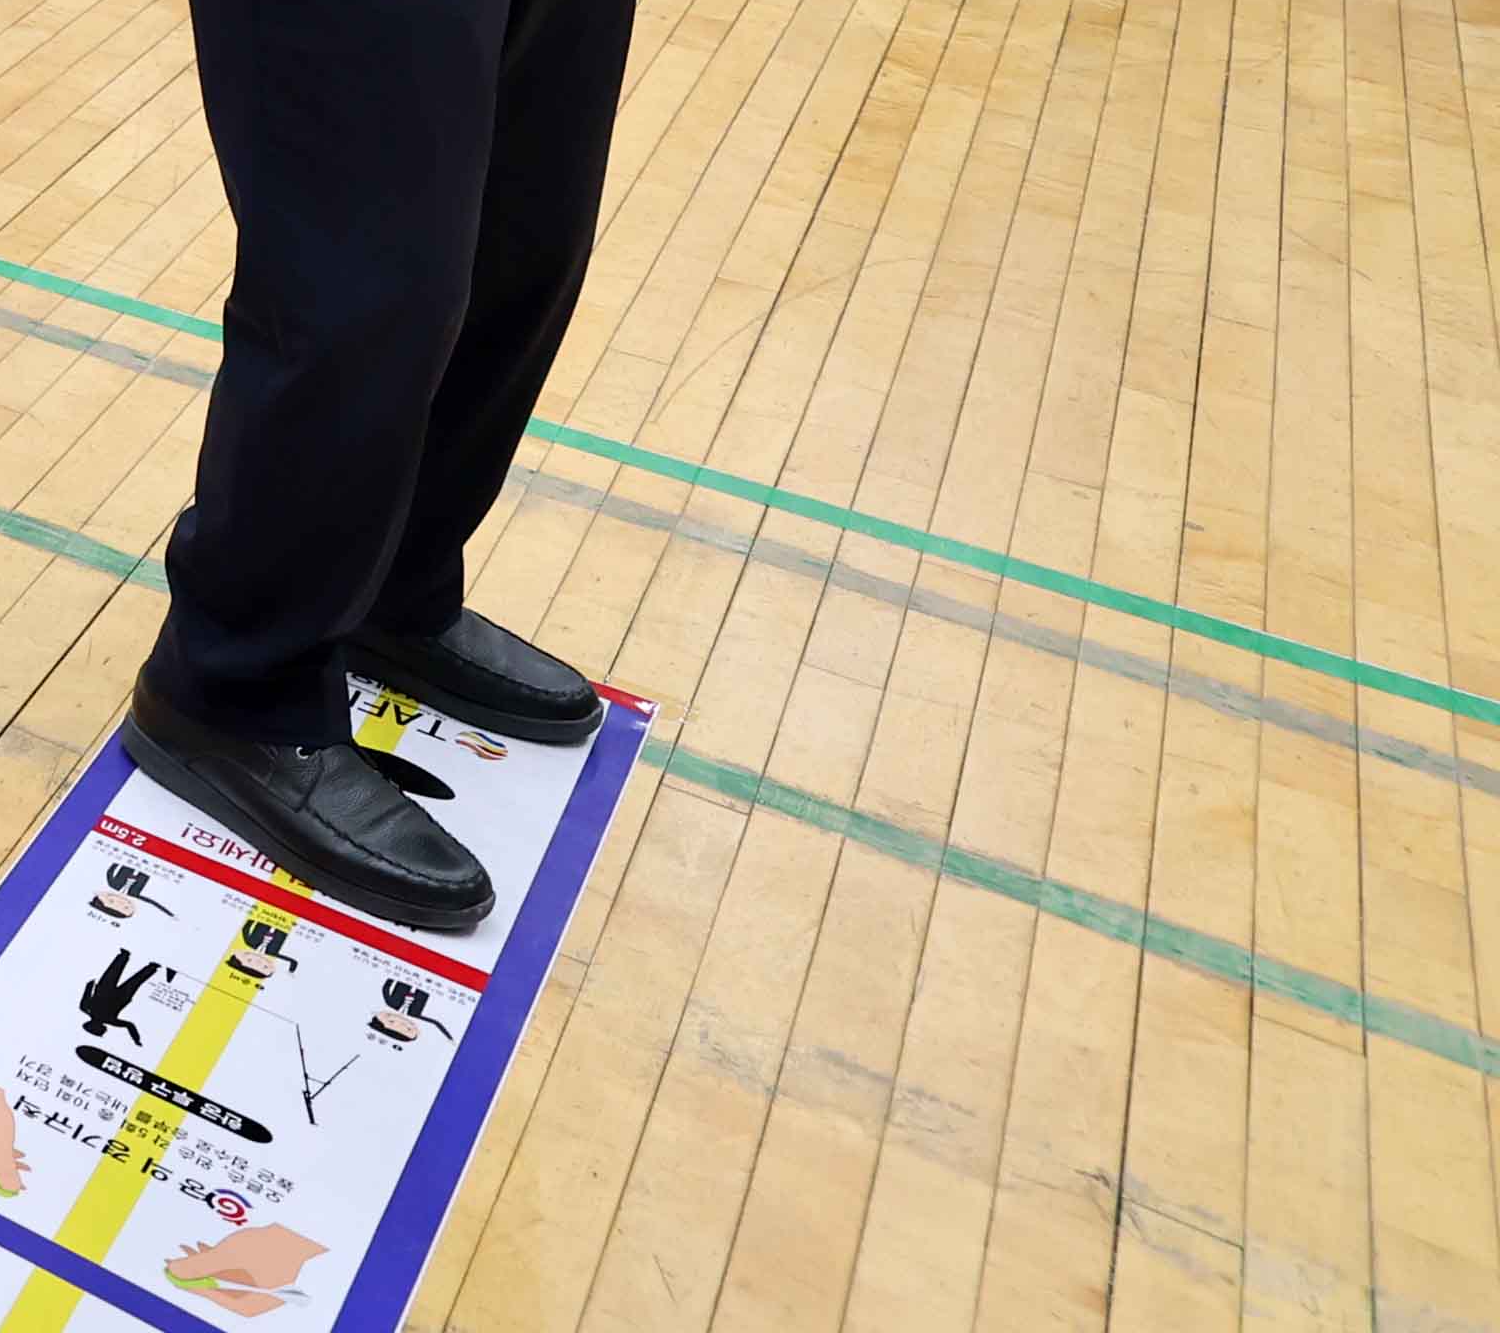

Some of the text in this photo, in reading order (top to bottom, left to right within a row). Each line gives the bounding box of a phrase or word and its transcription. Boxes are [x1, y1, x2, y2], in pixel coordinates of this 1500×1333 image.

[349, 690, 446, 741] TAFI
[101, 820, 147, 847] 2.5m
[101, 1055, 243, 1132] 한궁 투구 방법
[13, 1095, 131, 1163] 경기규칙
[141, 1157, 173, 1182] 의
